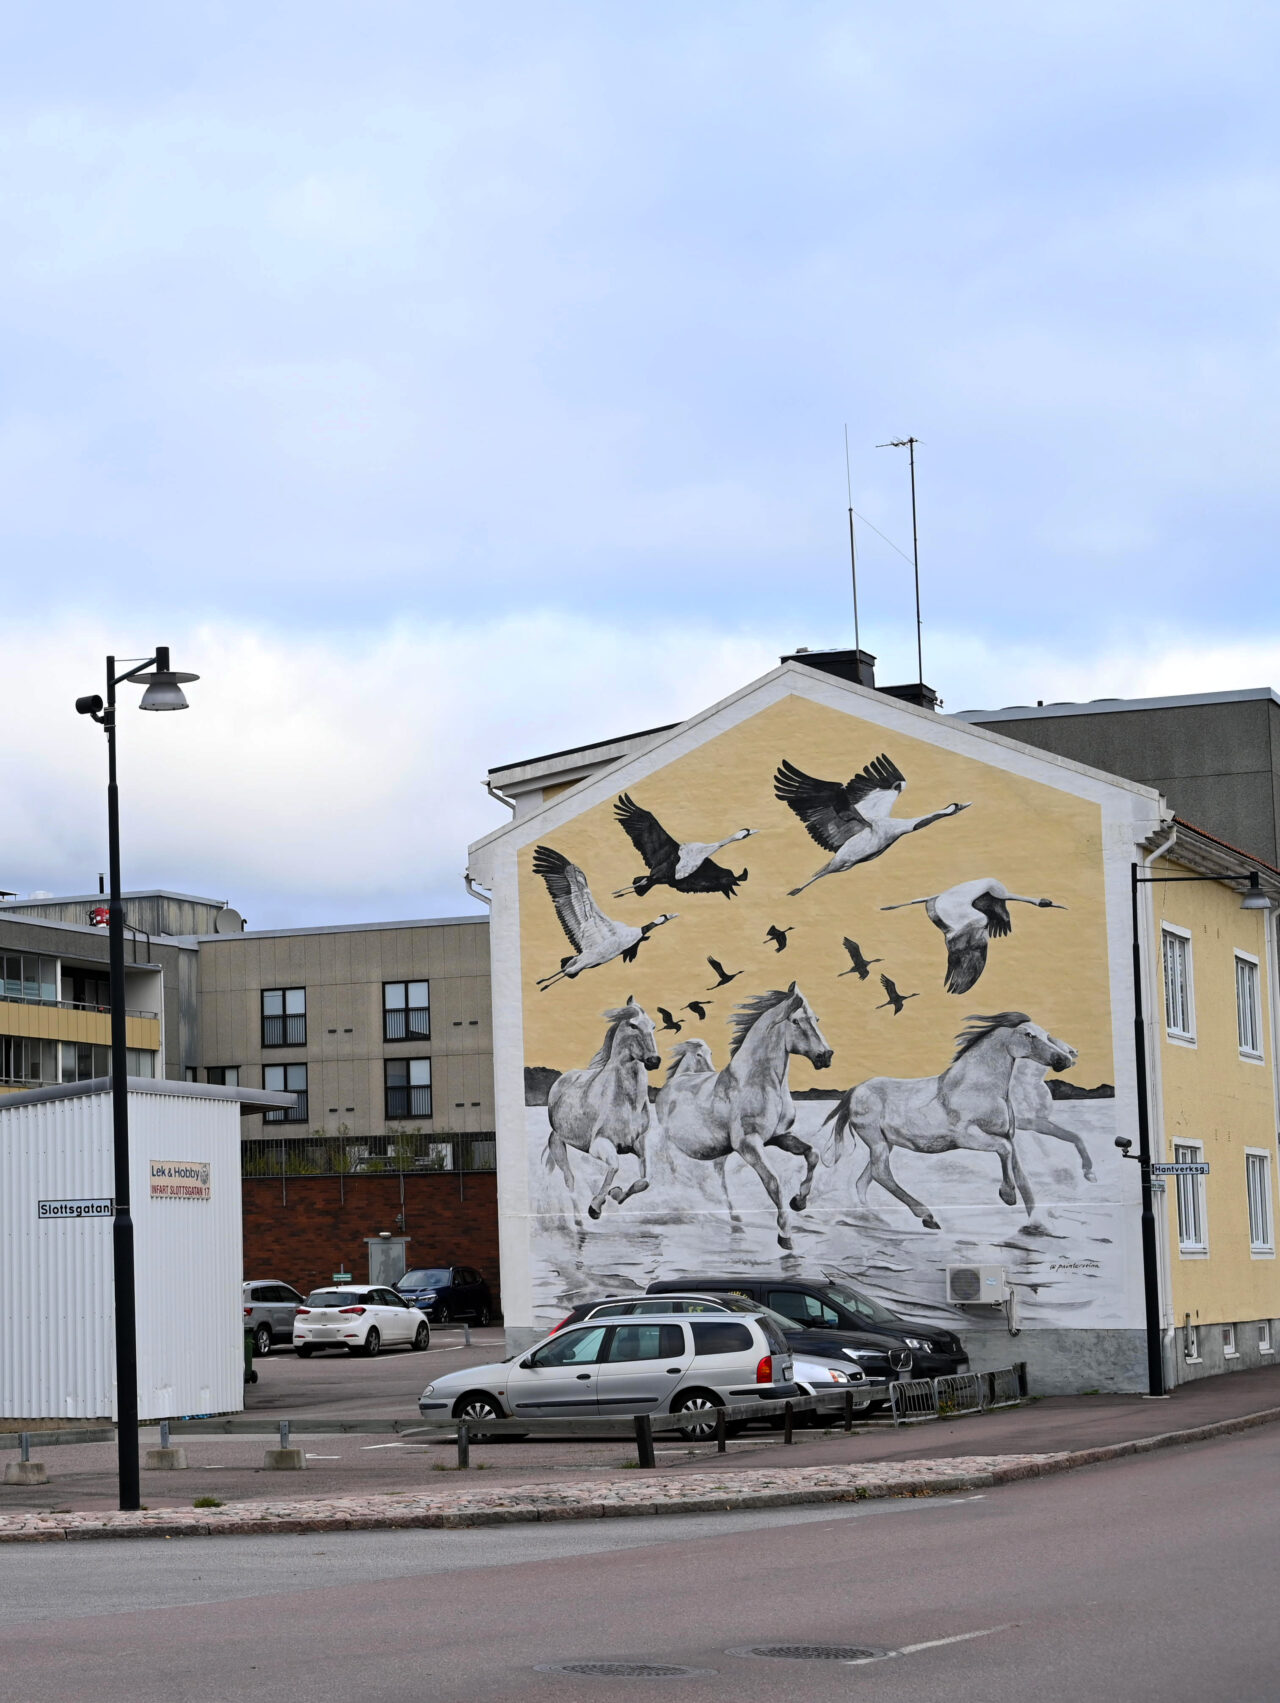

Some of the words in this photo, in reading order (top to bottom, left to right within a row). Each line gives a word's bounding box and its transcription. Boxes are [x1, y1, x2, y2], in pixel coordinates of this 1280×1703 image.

[151, 1165, 166, 1177] Lek
[167, 1167, 173, 1178] &
[174, 1166, 200, 1181] Hobby
[1154, 1166, 1208, 1175] Hantverksg.
[151, 1184, 169, 1195] INFART
[170, 1185, 203, 1196] SLOTTSGATAN
[204, 1187, 210, 1197] 17
[41, 1203, 110, 1217] Slottsgatan
